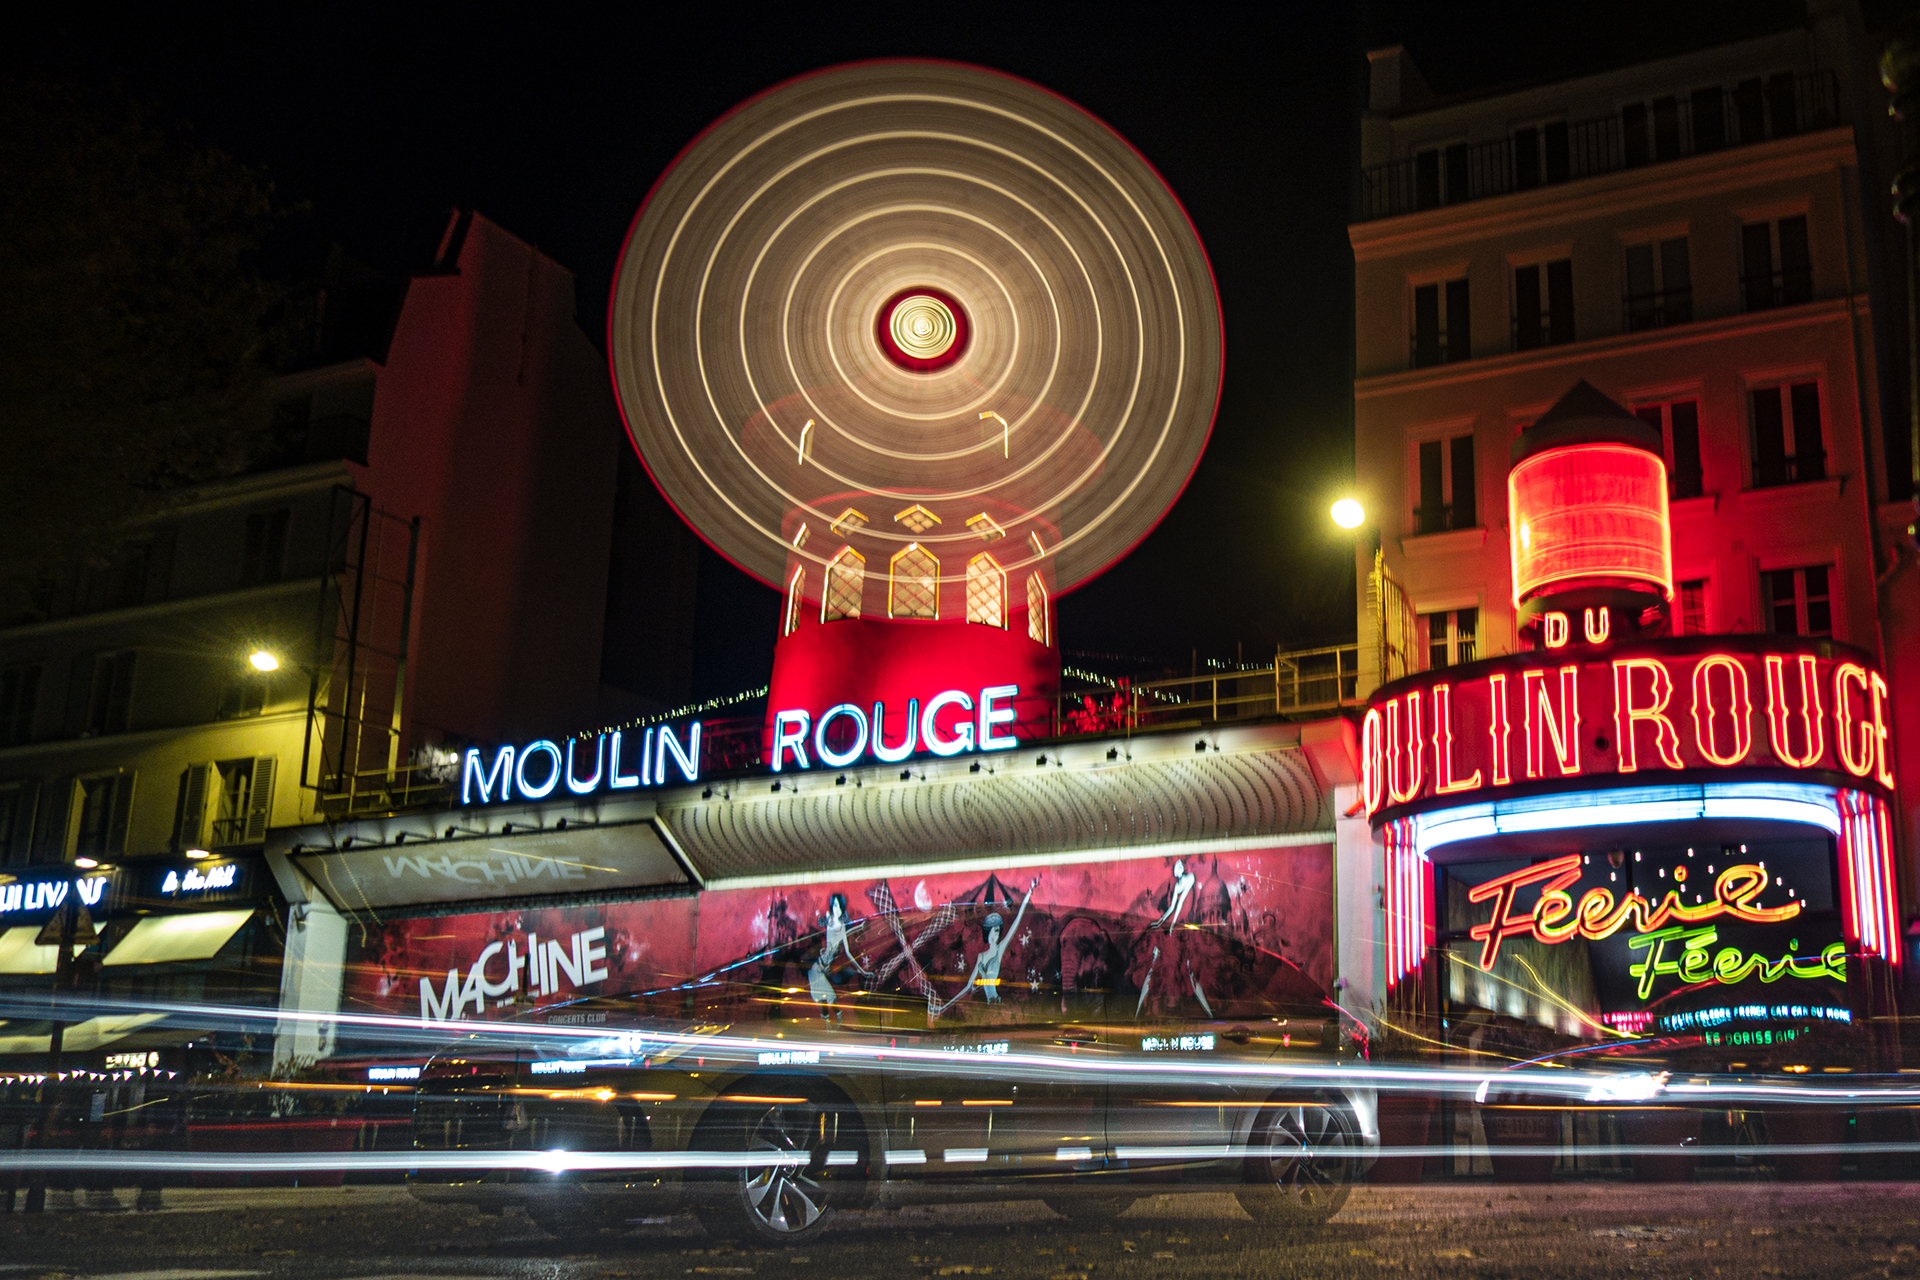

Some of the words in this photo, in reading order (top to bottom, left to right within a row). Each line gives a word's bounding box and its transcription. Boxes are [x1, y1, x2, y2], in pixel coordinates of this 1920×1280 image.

[1544, 606, 1610, 649] DU
[461, 721, 702, 804] MOULIN
[771, 684, 1020, 772] ROUGE
[1612, 654, 1895, 791] ROUGE
[419, 925, 609, 1031] MACHINE
[548, 1014, 585, 1024] CONCERTS
[586, 1012, 606, 1023] CLUB
